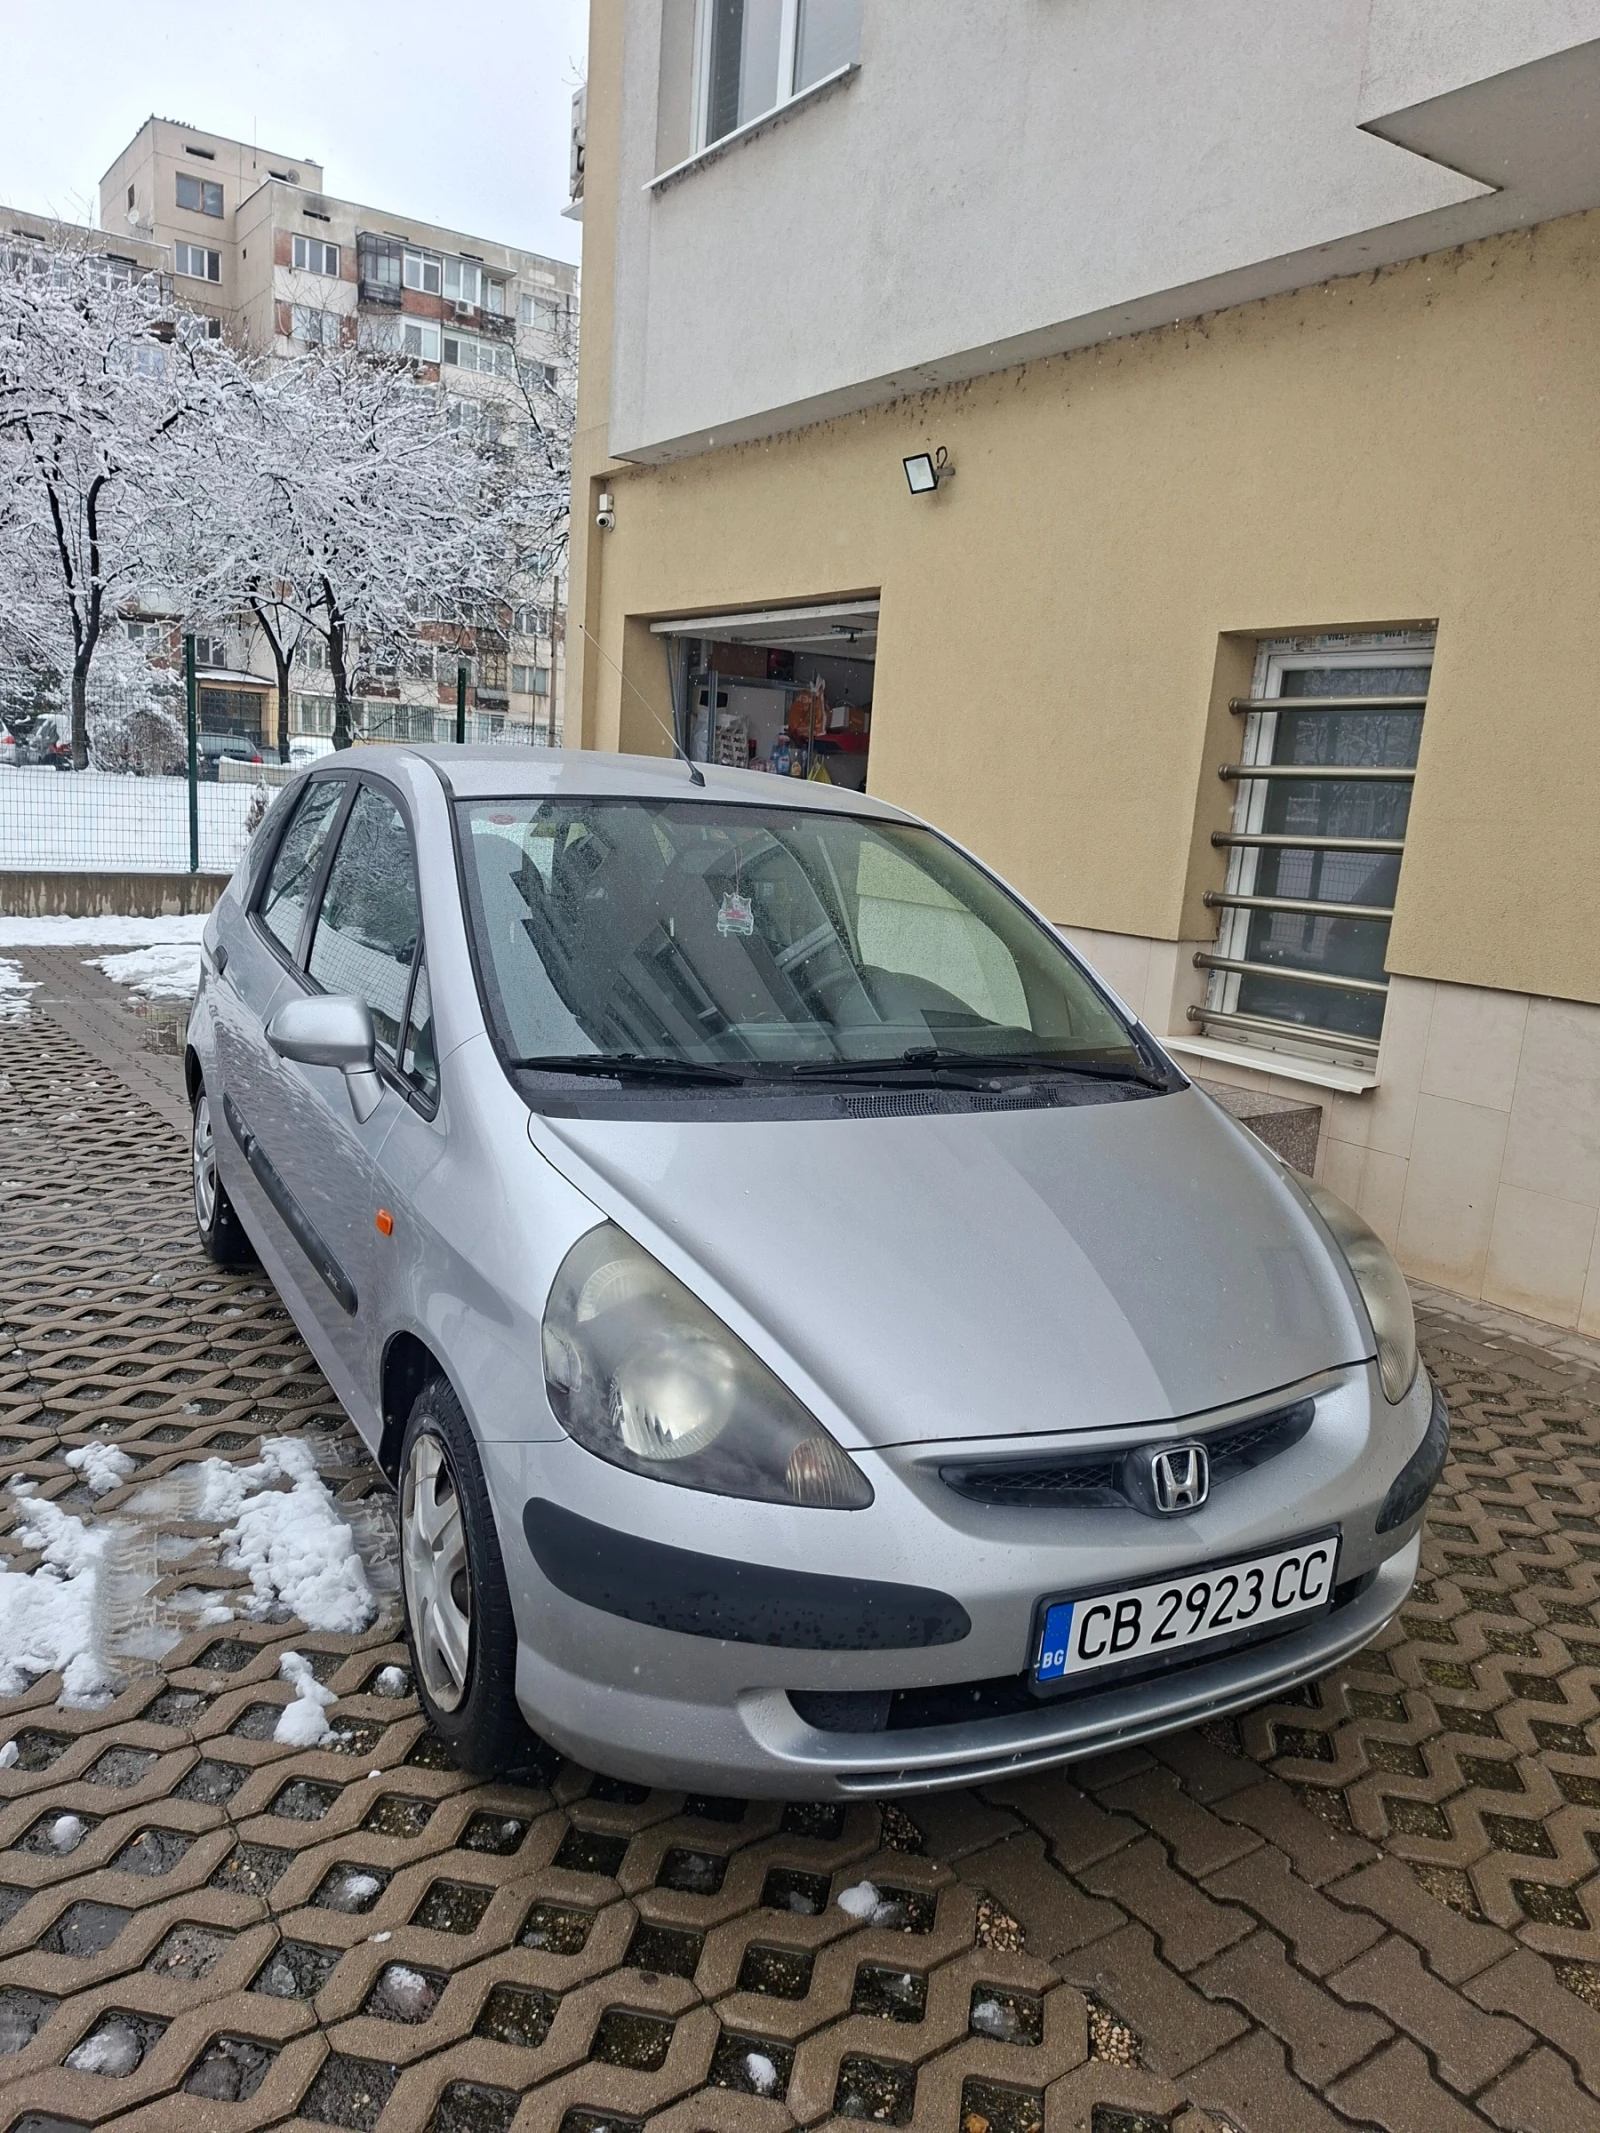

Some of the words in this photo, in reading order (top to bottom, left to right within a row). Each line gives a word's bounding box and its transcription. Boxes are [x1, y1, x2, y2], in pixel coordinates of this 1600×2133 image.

[1077, 1597, 1142, 1660] CB
[1150, 1568, 1264, 1644] 2923
[1271, 1549, 1328, 1609] CC
[1042, 1649, 1064, 1669] BG
